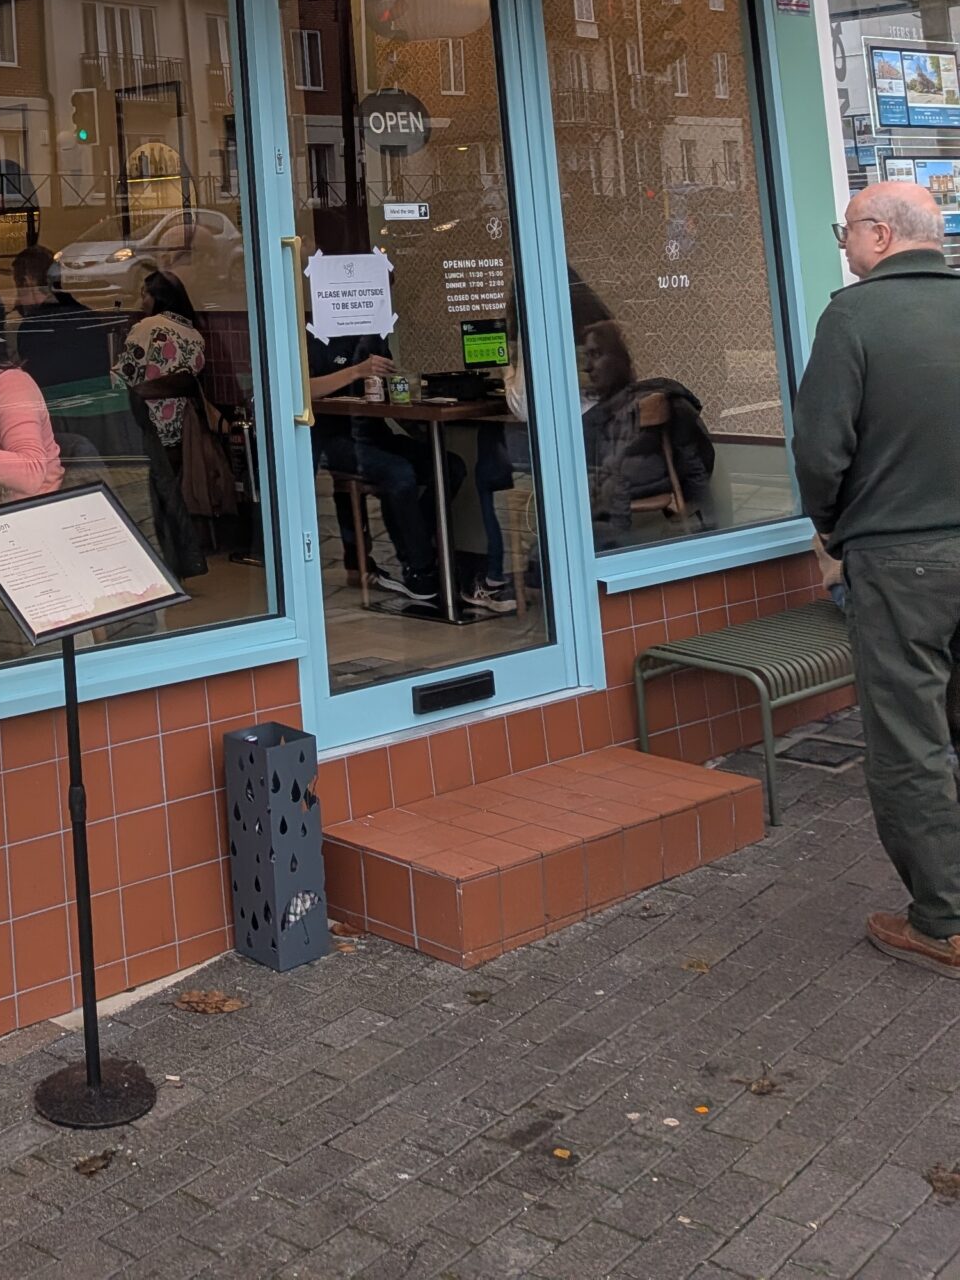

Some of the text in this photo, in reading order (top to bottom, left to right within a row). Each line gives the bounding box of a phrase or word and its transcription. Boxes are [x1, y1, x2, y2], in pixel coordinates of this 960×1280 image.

[369, 112, 425, 134] OPEN
[443, 259, 504, 269] OPENING HOURS
[658, 275, 690, 288] won
[317, 288, 384, 298] PLEASE WAIT OUTSIDE
[481, 292, 504, 300] MONDAY
[351, 301, 374, 309] SEATED
[481, 303, 506, 311] TUESDAY
